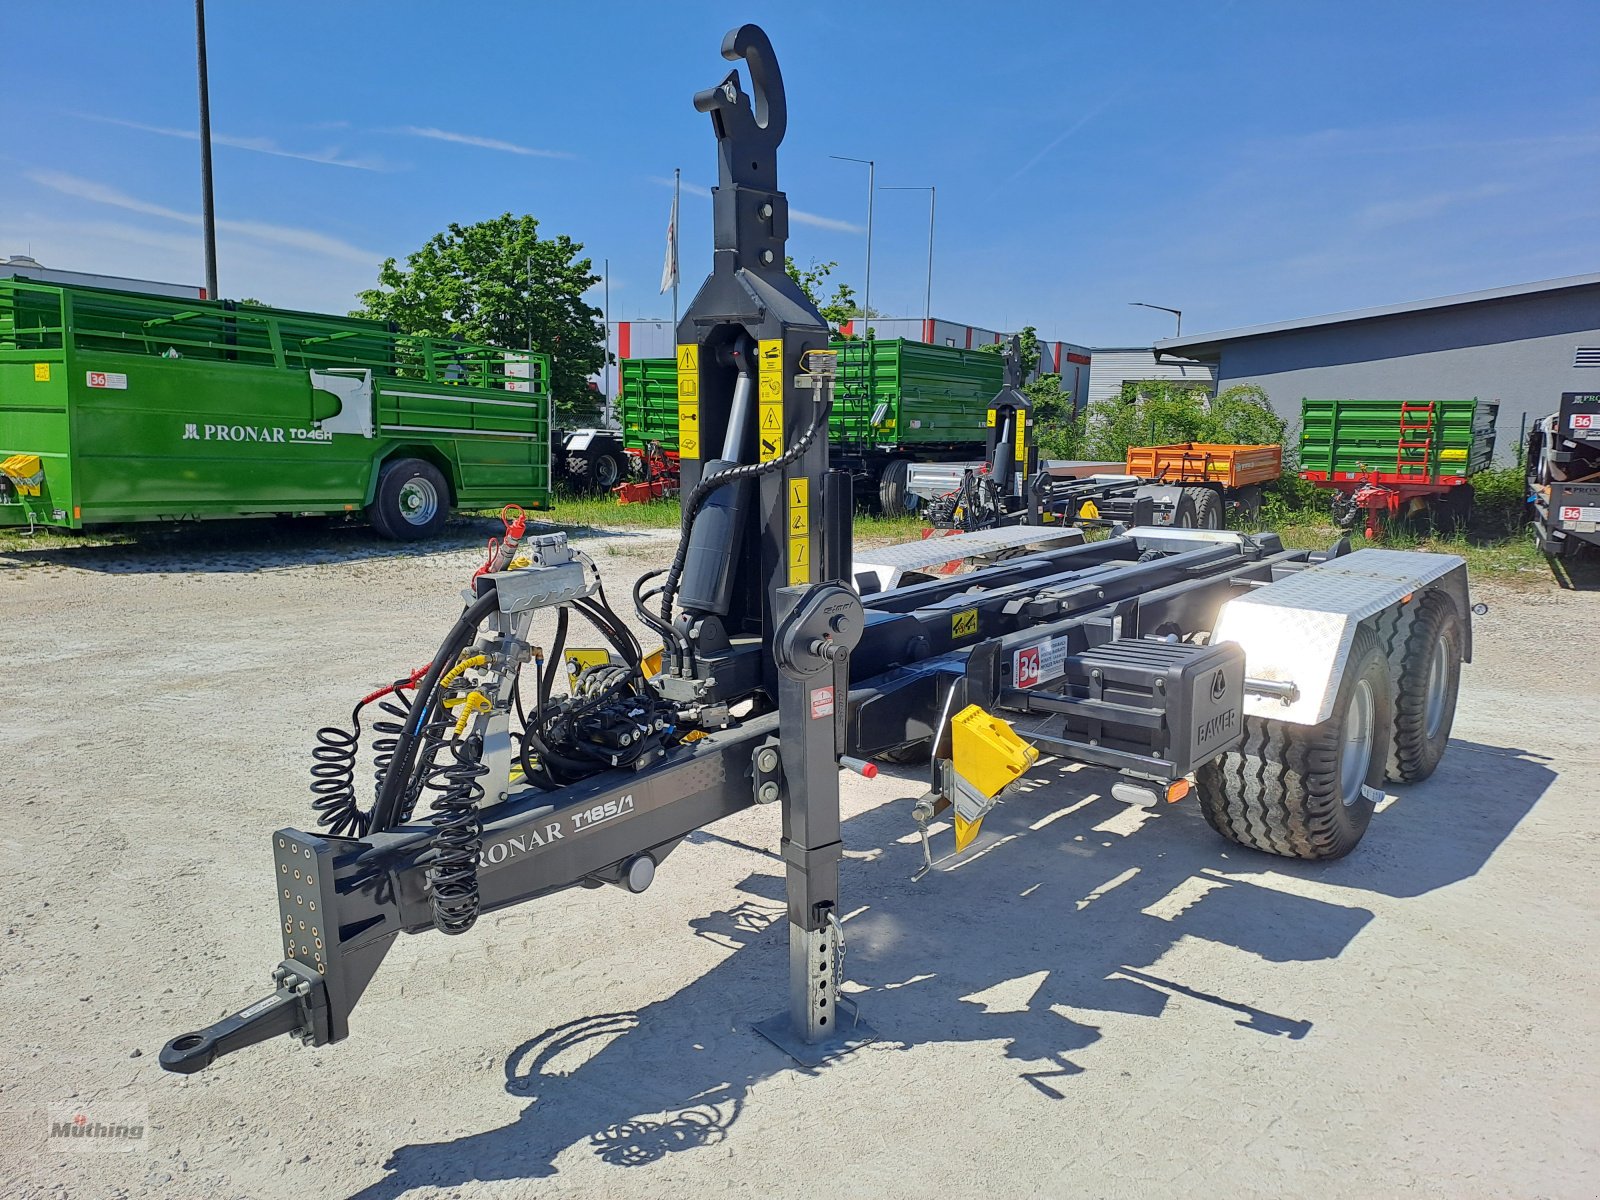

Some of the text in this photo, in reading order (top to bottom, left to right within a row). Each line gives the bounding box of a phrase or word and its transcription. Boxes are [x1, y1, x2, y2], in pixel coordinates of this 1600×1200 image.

[91, 374, 105, 385] 36
[1575, 416, 1591, 427] 36
[203, 424, 286, 443] PRONAR
[1563, 508, 1580, 519] 36
[1020, 652, 1039, 682] 36
[1197, 708, 1236, 746] BAWER
[470, 794, 635, 870] RONAR T185/1
